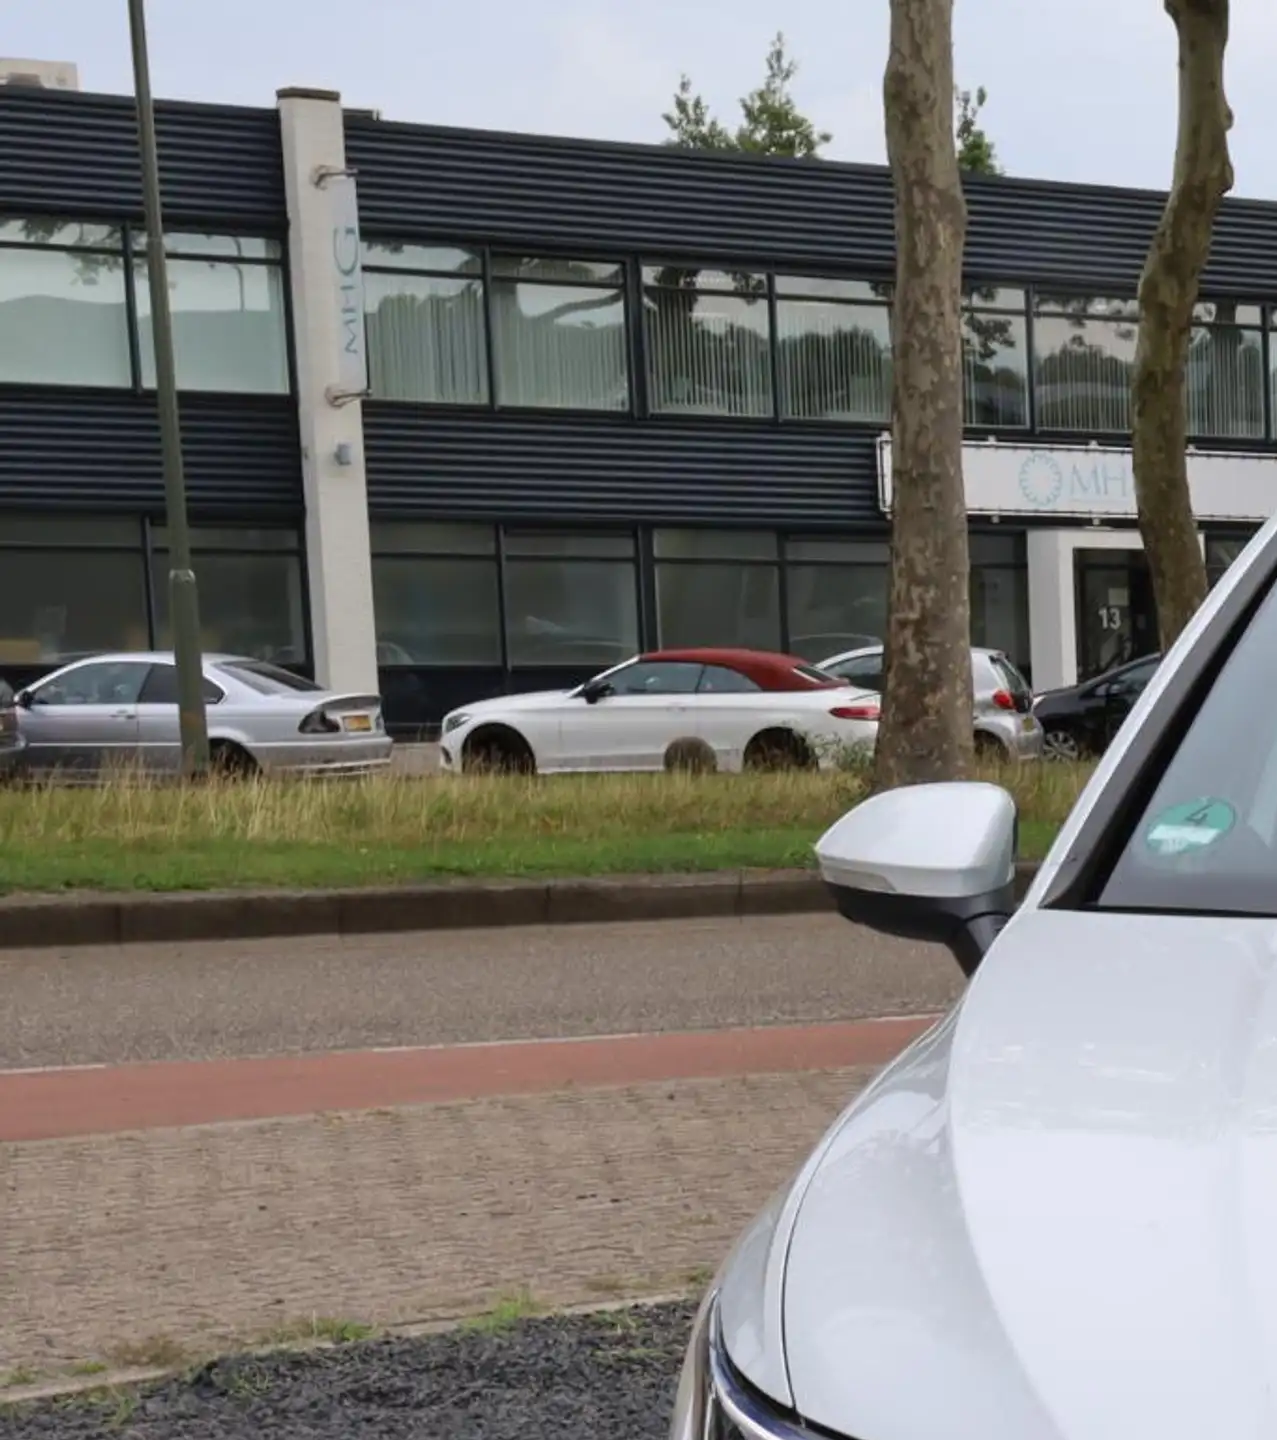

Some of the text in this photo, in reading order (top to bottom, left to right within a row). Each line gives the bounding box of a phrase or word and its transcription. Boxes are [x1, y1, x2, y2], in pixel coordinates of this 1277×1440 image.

[333, 226, 359, 354] MHG
[1070, 463, 1128, 497] MH
[1098, 607, 1121, 630] 13
[1184, 804, 1213, 827] 4
